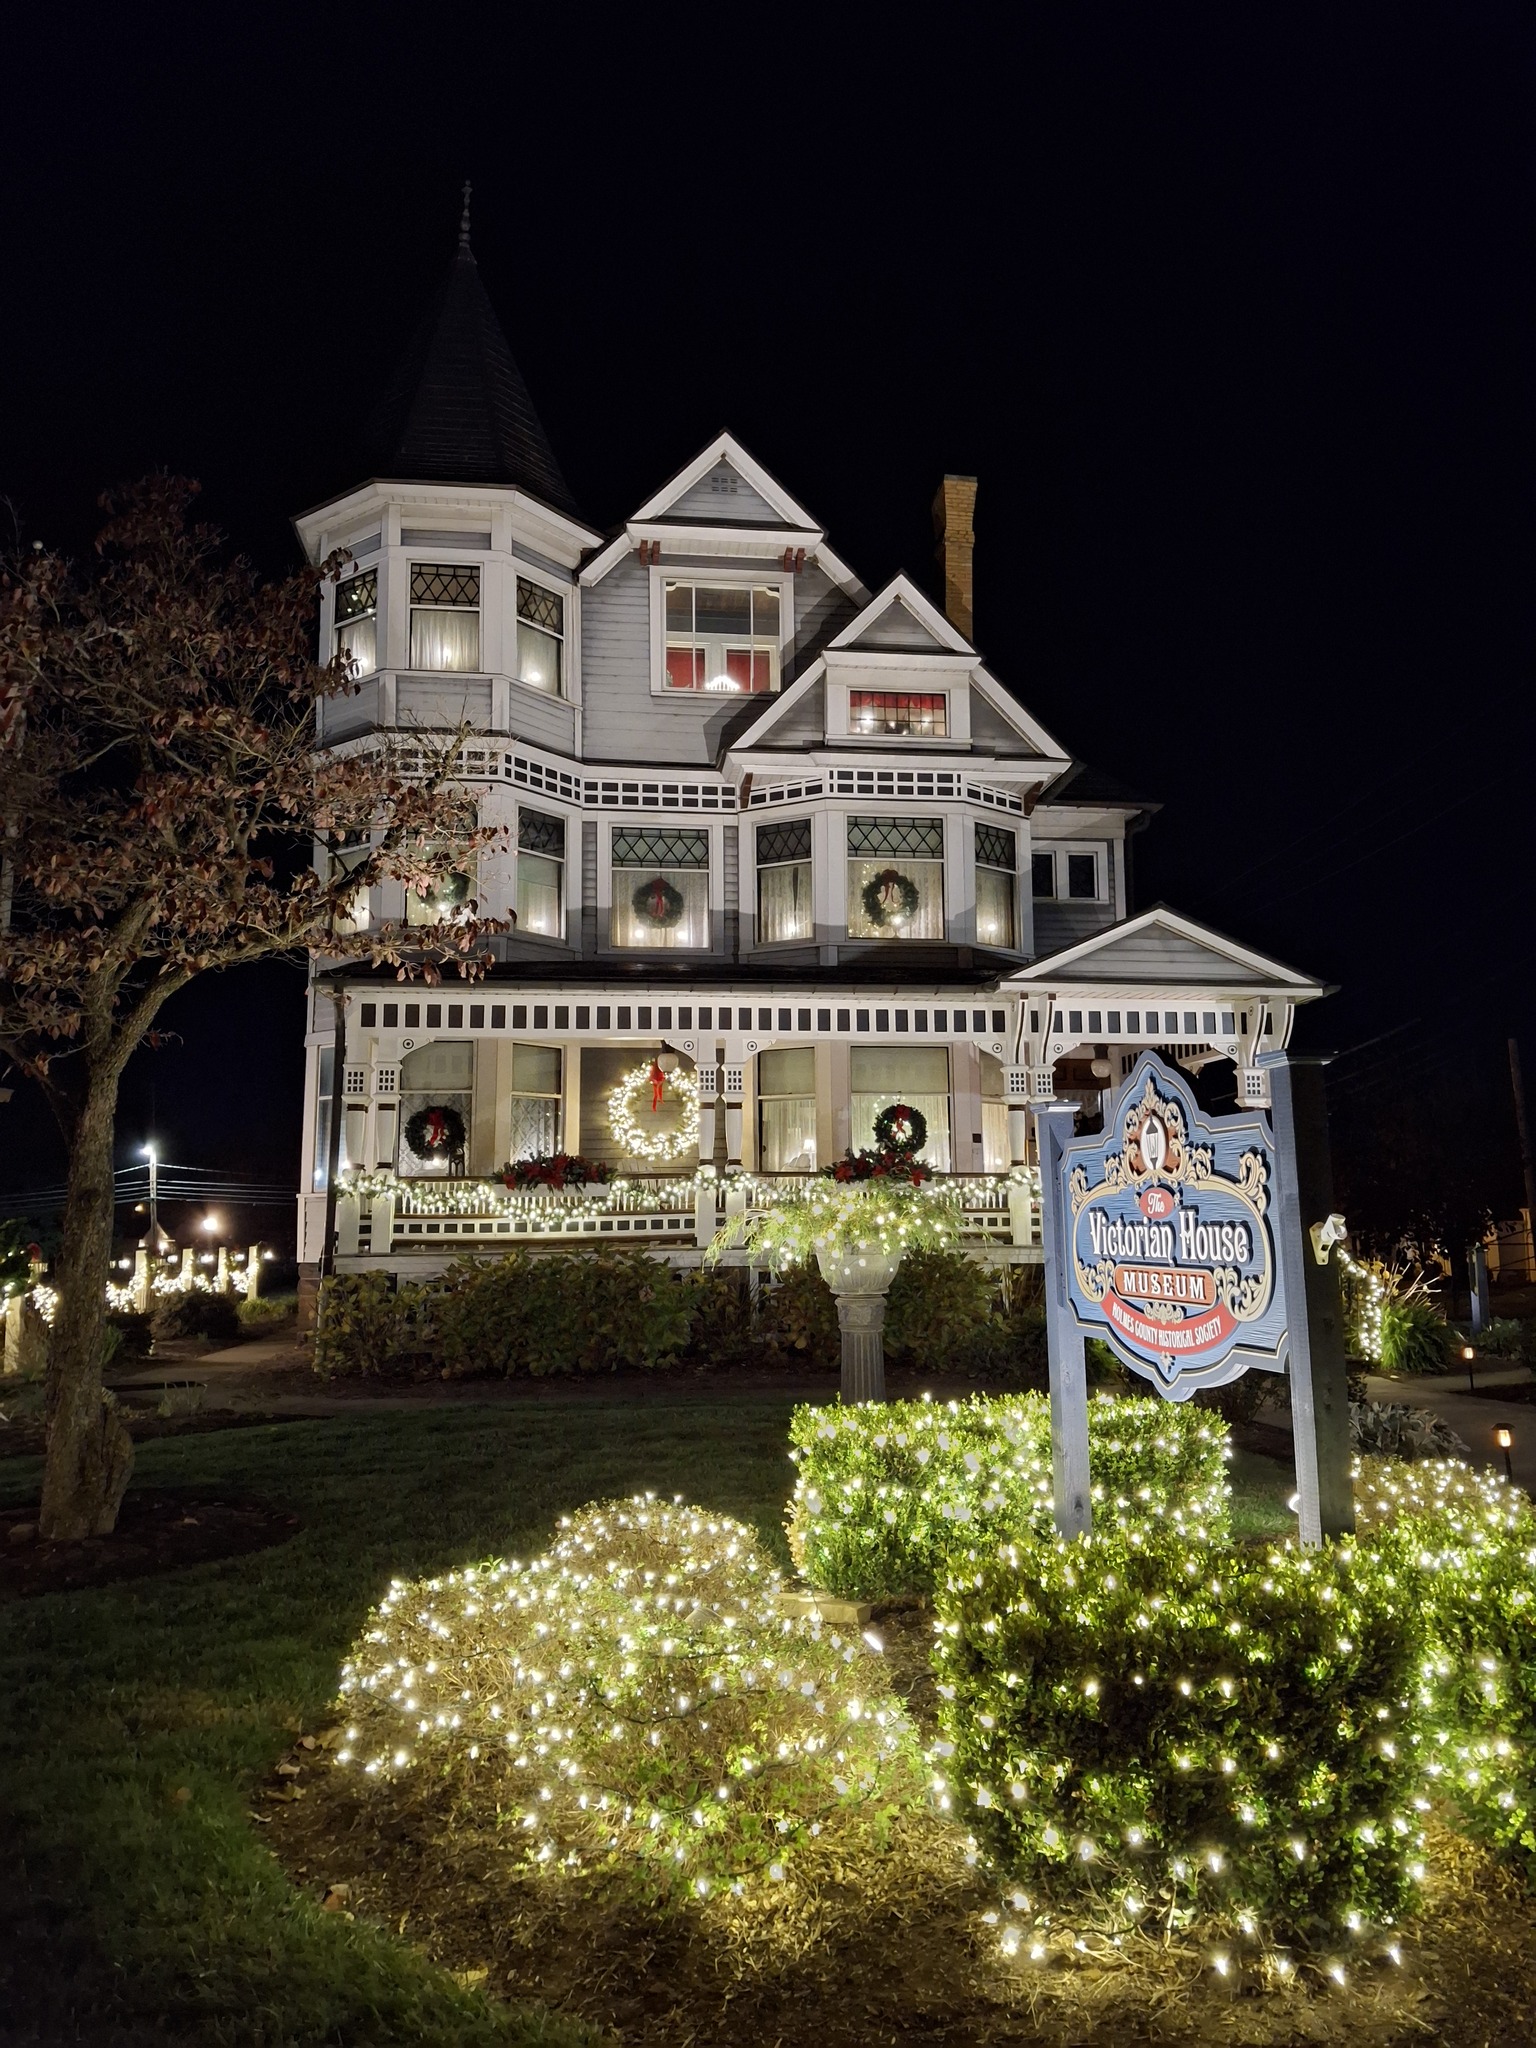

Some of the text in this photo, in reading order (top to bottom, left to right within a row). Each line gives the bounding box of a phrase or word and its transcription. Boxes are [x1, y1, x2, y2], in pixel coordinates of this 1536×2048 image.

[1147, 1193, 1165, 1214] The
[1088, 1211, 1248, 1263] Victorian House
[1123, 1271, 1205, 1300] MUSEUM
[1112, 1303, 1221, 1348] HOLMES COUNTY HISTORICAL SOCIETY
